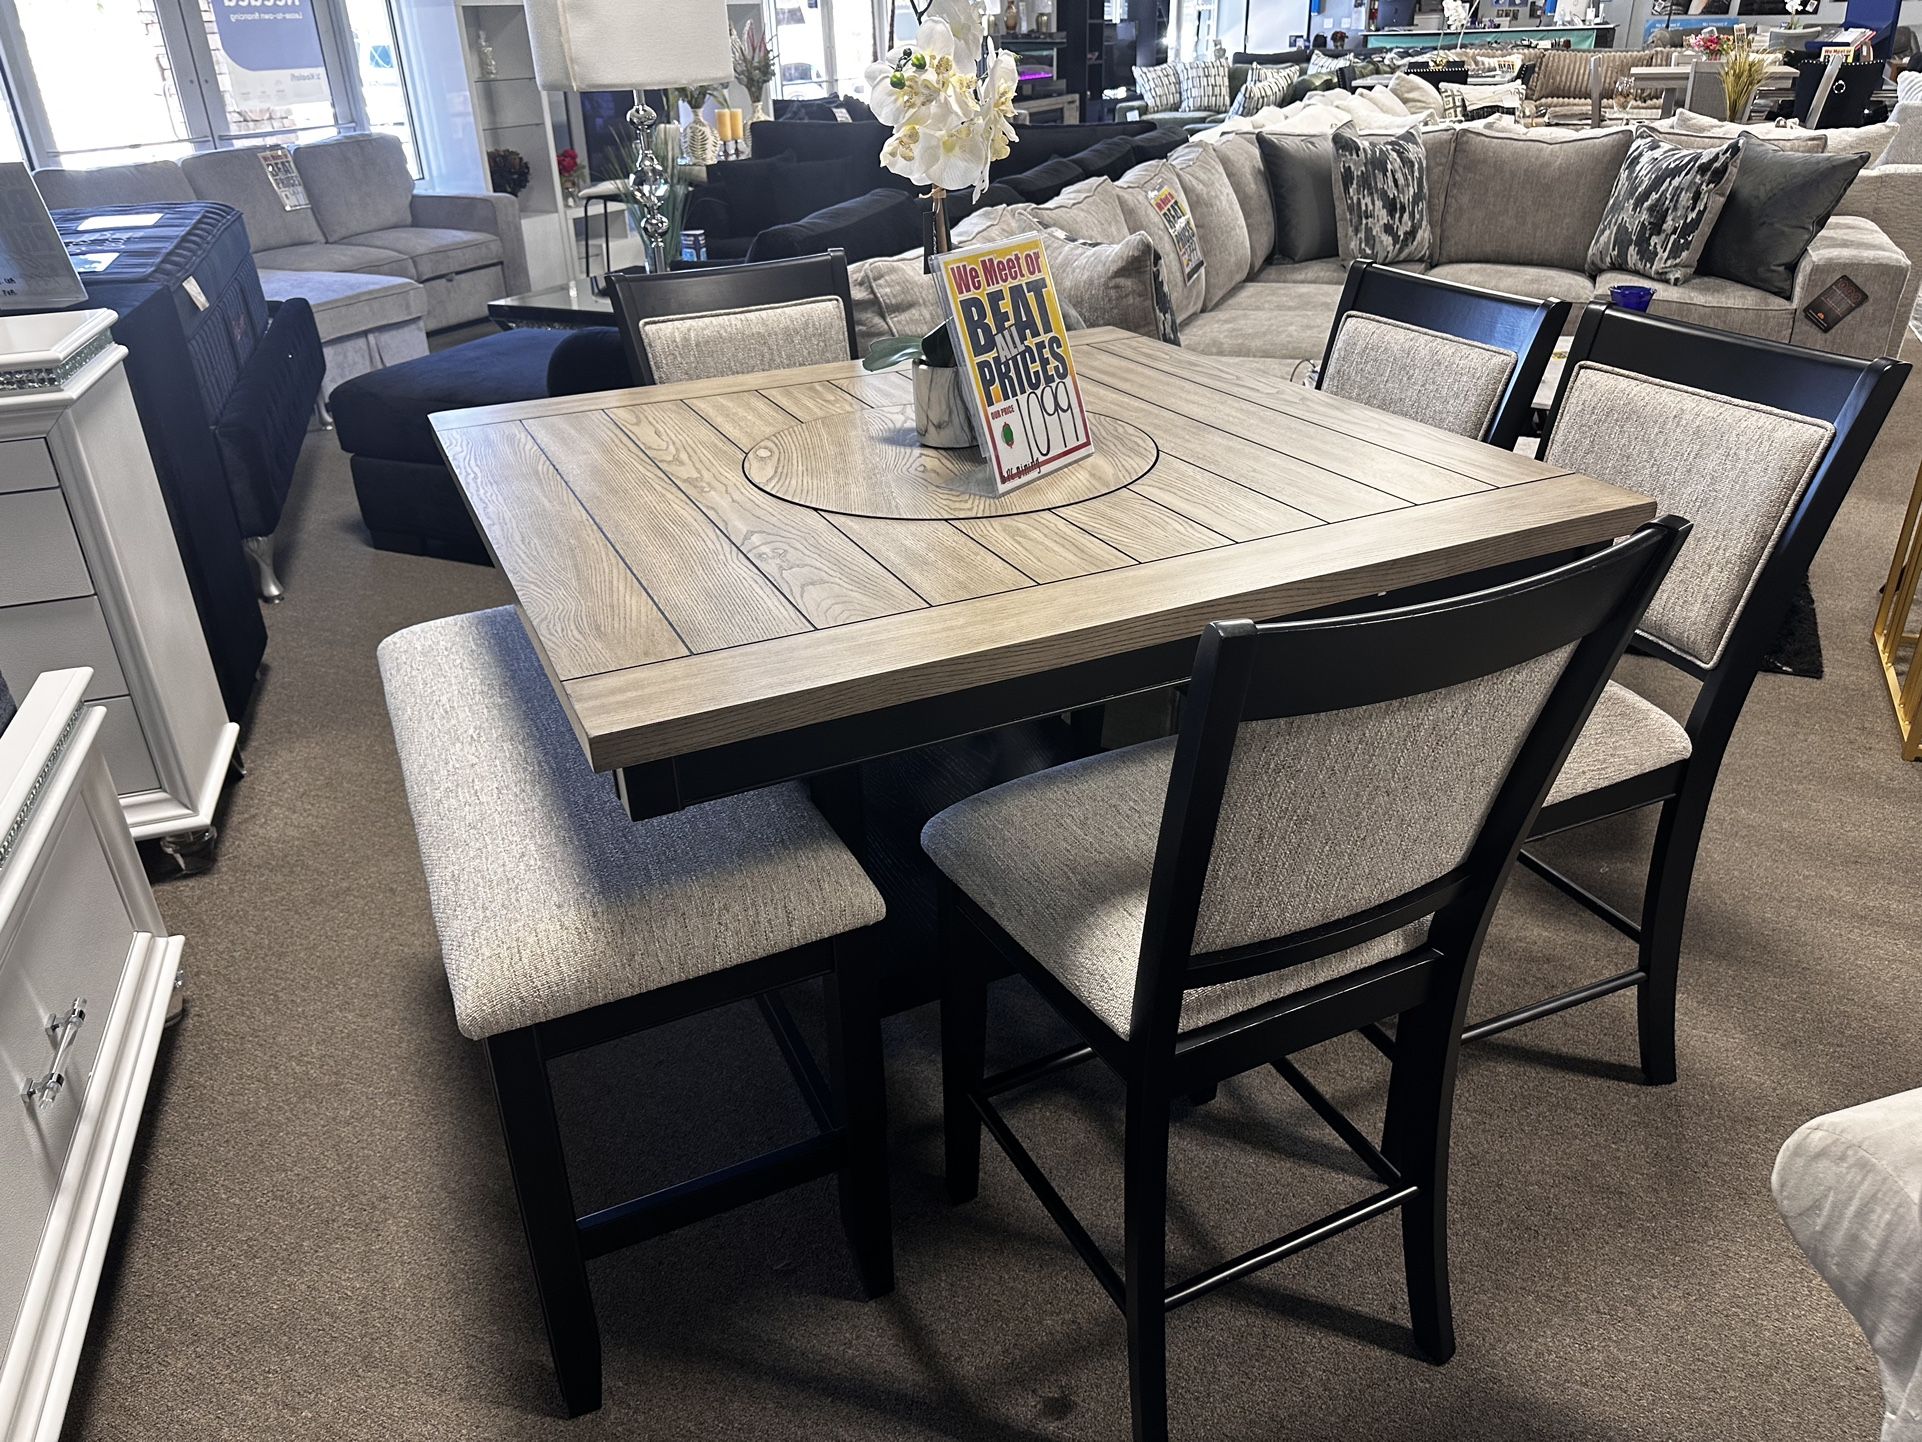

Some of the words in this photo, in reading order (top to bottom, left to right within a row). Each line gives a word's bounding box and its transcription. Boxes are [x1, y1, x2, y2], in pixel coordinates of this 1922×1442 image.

[266, 160, 295, 177] BEAT
[1162, 200, 1187, 230] BEAT
[950, 262, 982, 295] We
[981, 252, 1026, 286] Meet
[1025, 250, 1042, 277] or
[959, 278, 1053, 358] BEAT
[994, 325, 1026, 363] ALL
[976, 335, 1069, 408] PRICES
[990, 409, 1002, 420] OUR
[1000, 404, 1015, 417] PRICE
[1015, 380, 1080, 462] 1099
